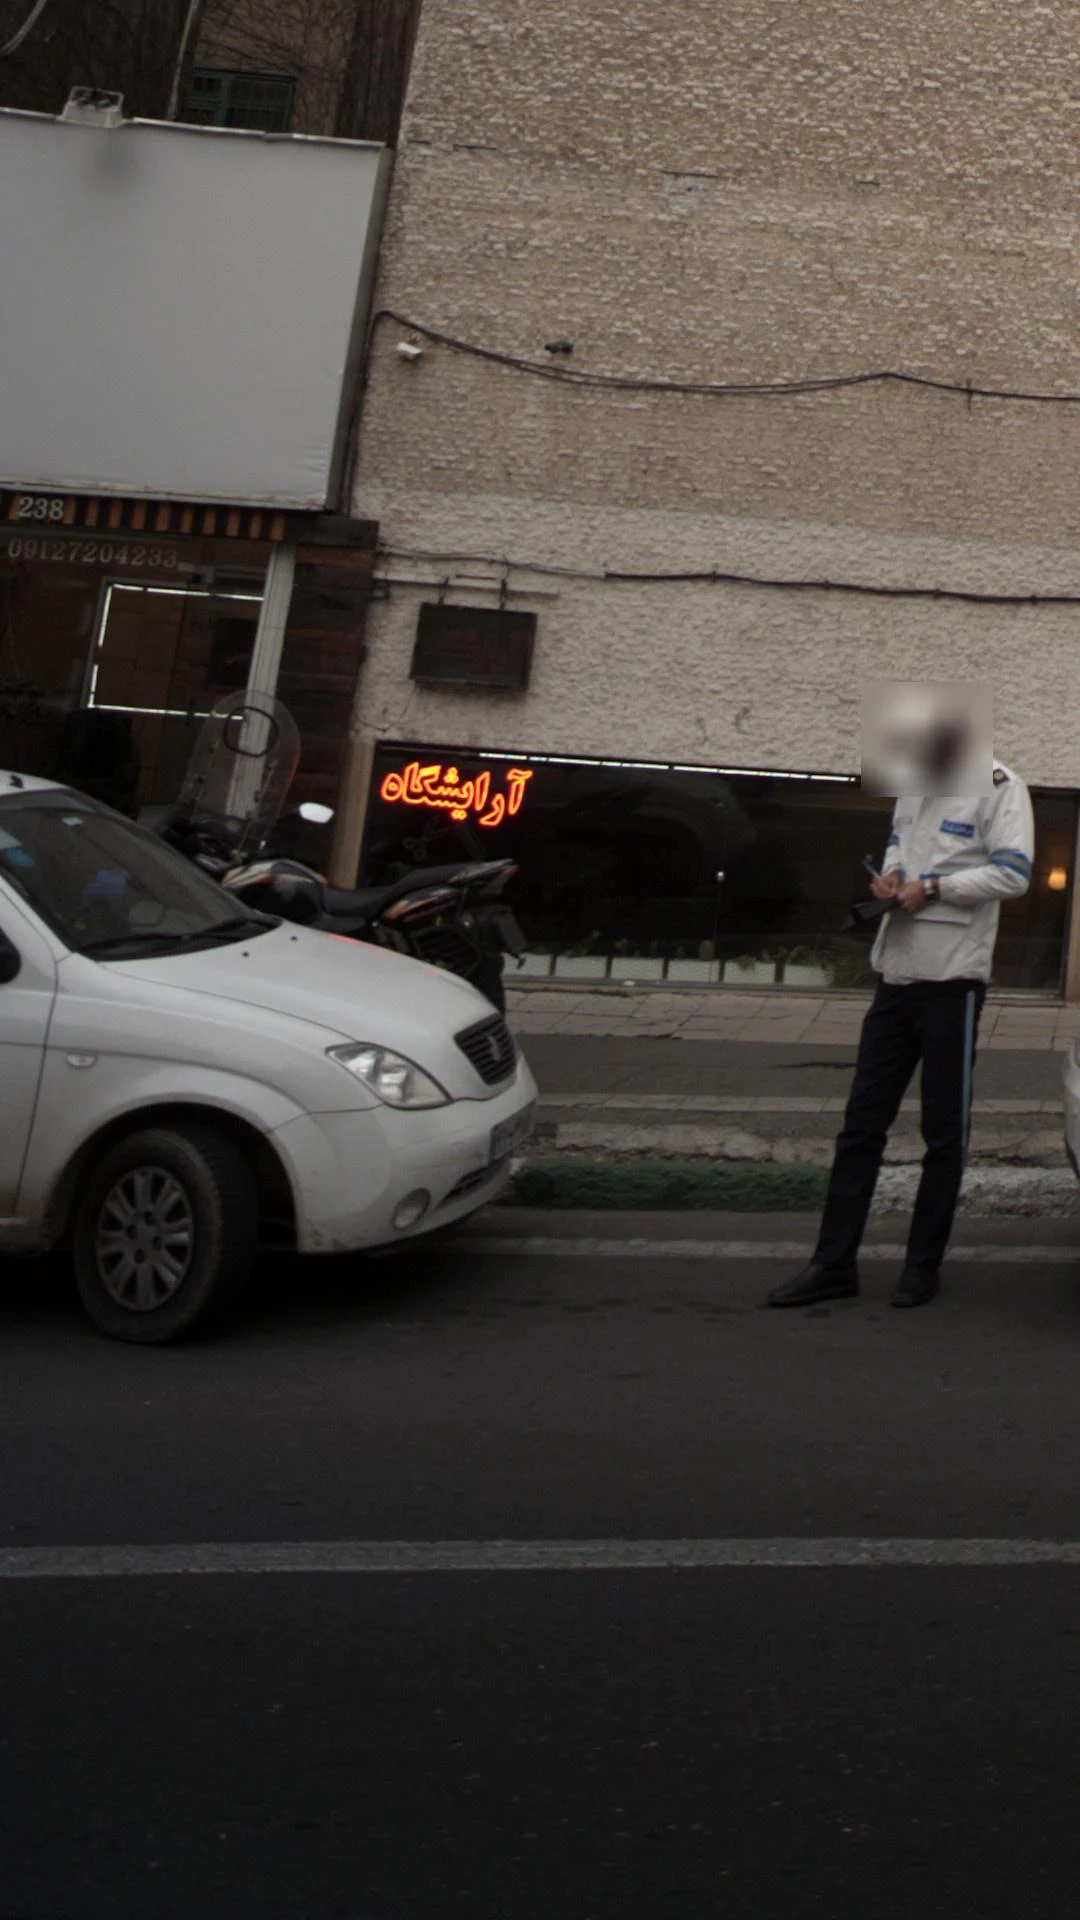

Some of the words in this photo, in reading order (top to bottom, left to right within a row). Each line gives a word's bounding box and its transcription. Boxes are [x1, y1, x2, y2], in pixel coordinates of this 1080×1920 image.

[19, 496, 64, 520] 238
[8, 538, 178, 569] 09127204233
[382, 763, 532, 825] آرایشگاه
